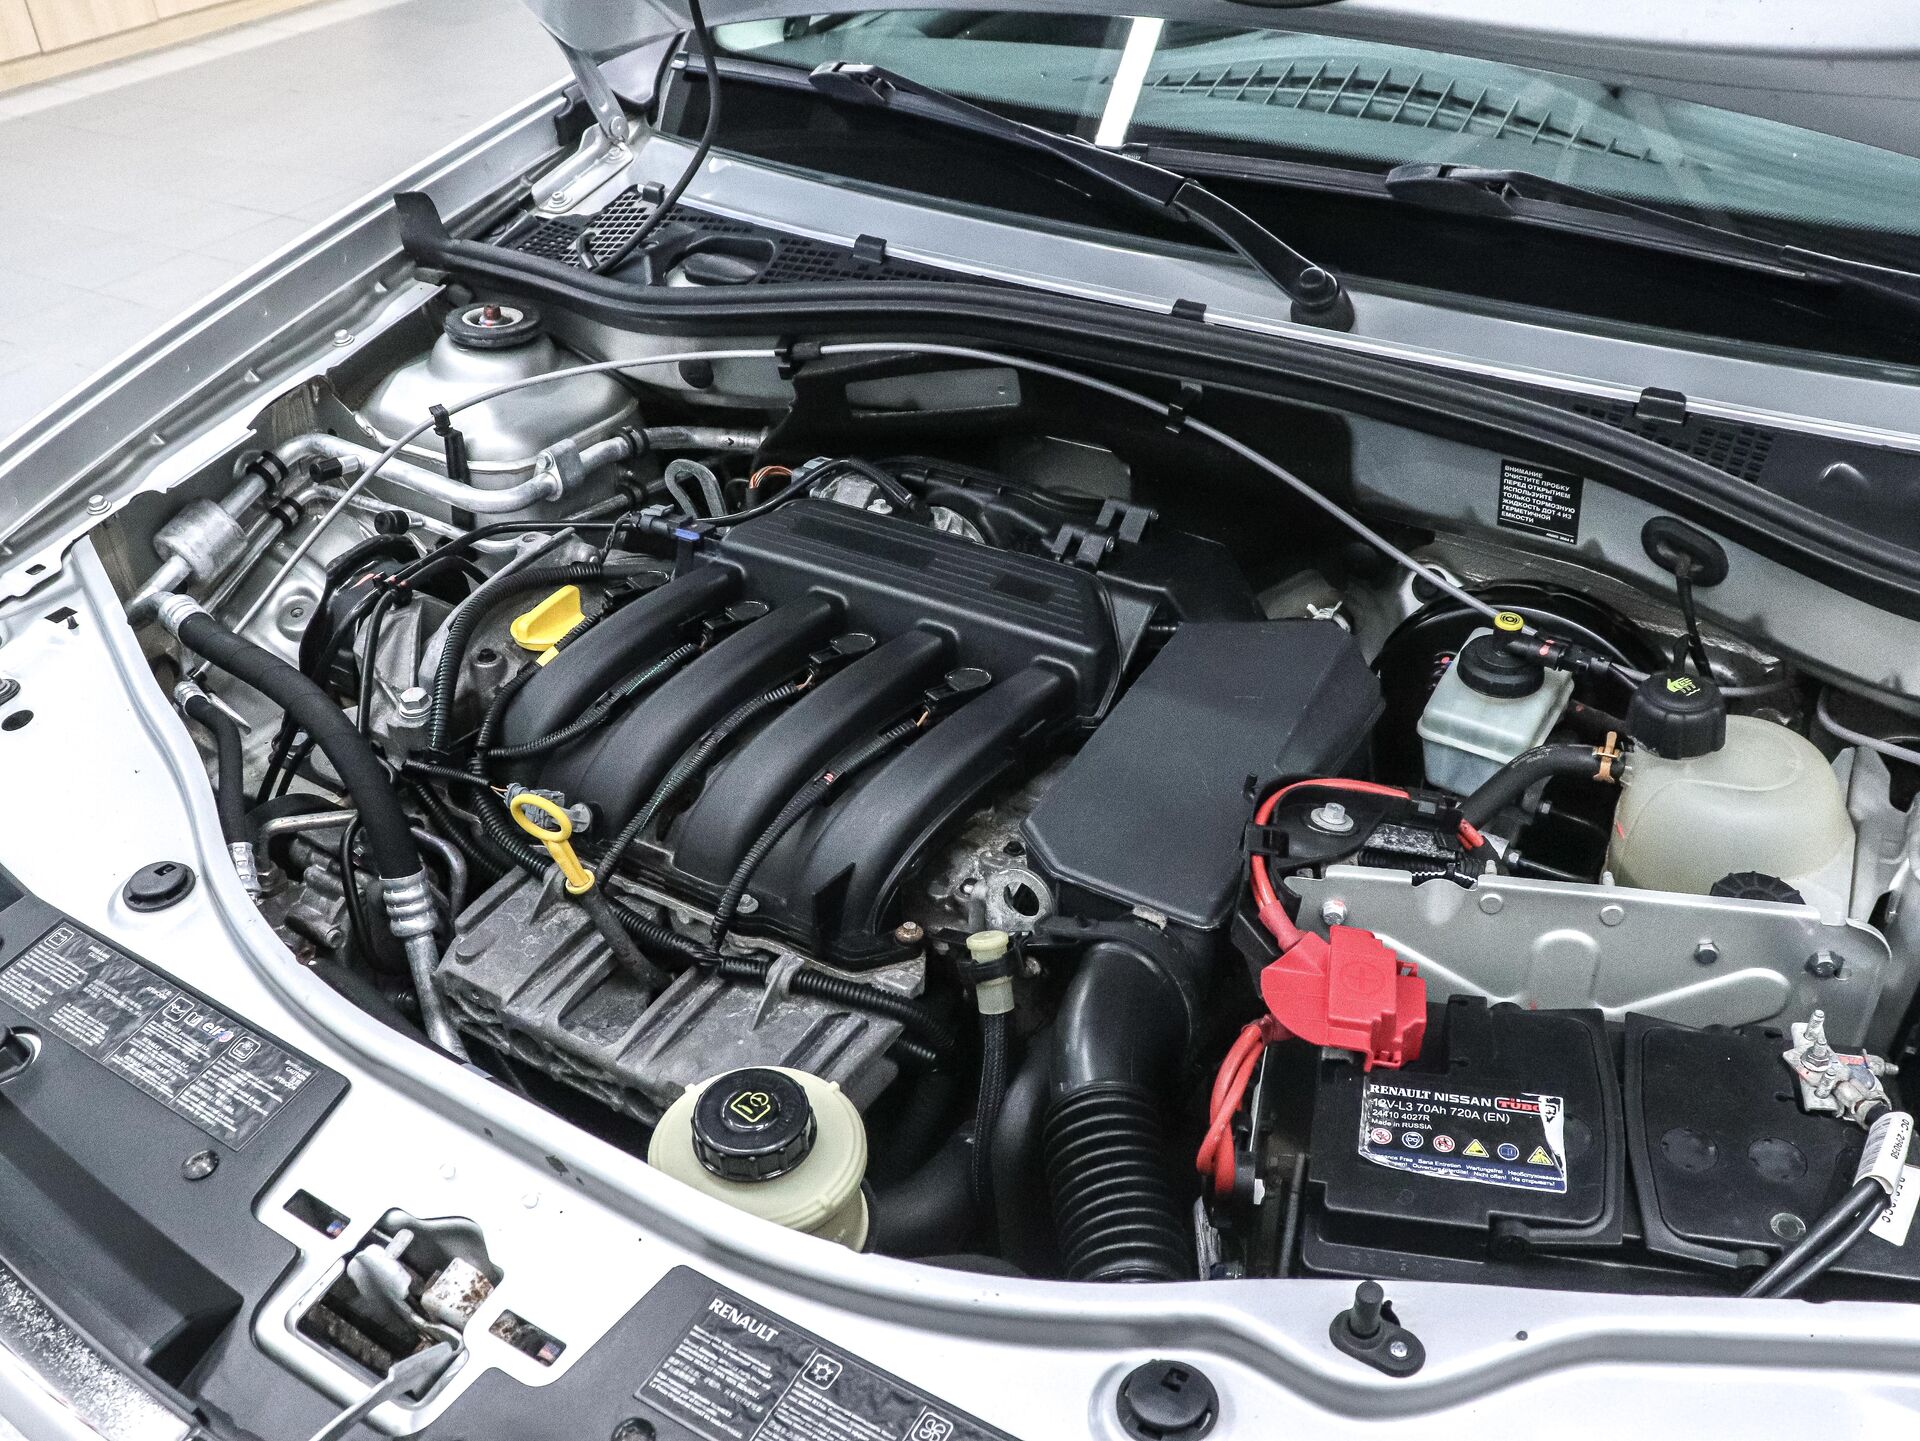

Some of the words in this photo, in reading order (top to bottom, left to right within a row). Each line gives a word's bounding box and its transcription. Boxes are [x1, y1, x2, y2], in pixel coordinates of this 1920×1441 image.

[1504, 465, 1543, 479] ВНИМАНИЕ
[1503, 478, 1527, 489] ПЕРЕД
[1527, 484, 1571, 499] ОТКРЫТИЕМ
[1504, 472, 1540, 484] ОЧИСТИТЕ
[1541, 480, 1570, 492] ПРОБКУ
[1503, 485, 1553, 501] ИСПОЛЬЗУЙТЕ
[1502, 498, 1541, 511] ЖИДКОСТЬ
[1541, 507, 1556, 515] ДОТ
[1562, 512, 1572, 520] ИЗ
[1503, 491, 1531, 502] ТОЛЬКО
[1532, 498, 1576, 514] ТОРМОЗНУЮ
[1501, 504, 1551, 521] ГЕРМЕТИЧНОЙ
[1501, 511, 1534, 523] ЕМКОСТИ
[202, 1022, 225, 1036] elf
[1369, 1084, 1431, 1100] RENAULT
[1434, 1092, 1491, 1107] NISSAN
[1372, 1109, 1399, 1119] 24410
[1401, 1113, 1430, 1122] 4027R
[1416, 1103, 1447, 1115] 70Ah
[1450, 1107, 1480, 1120] 720A
[1483, 1112, 1510, 1124] (EN)
[1371, 1118, 1392, 1127] Made
[1401, 1122, 1433, 1130] RUSSIA
[708, 1298, 779, 1342] RENAULT
